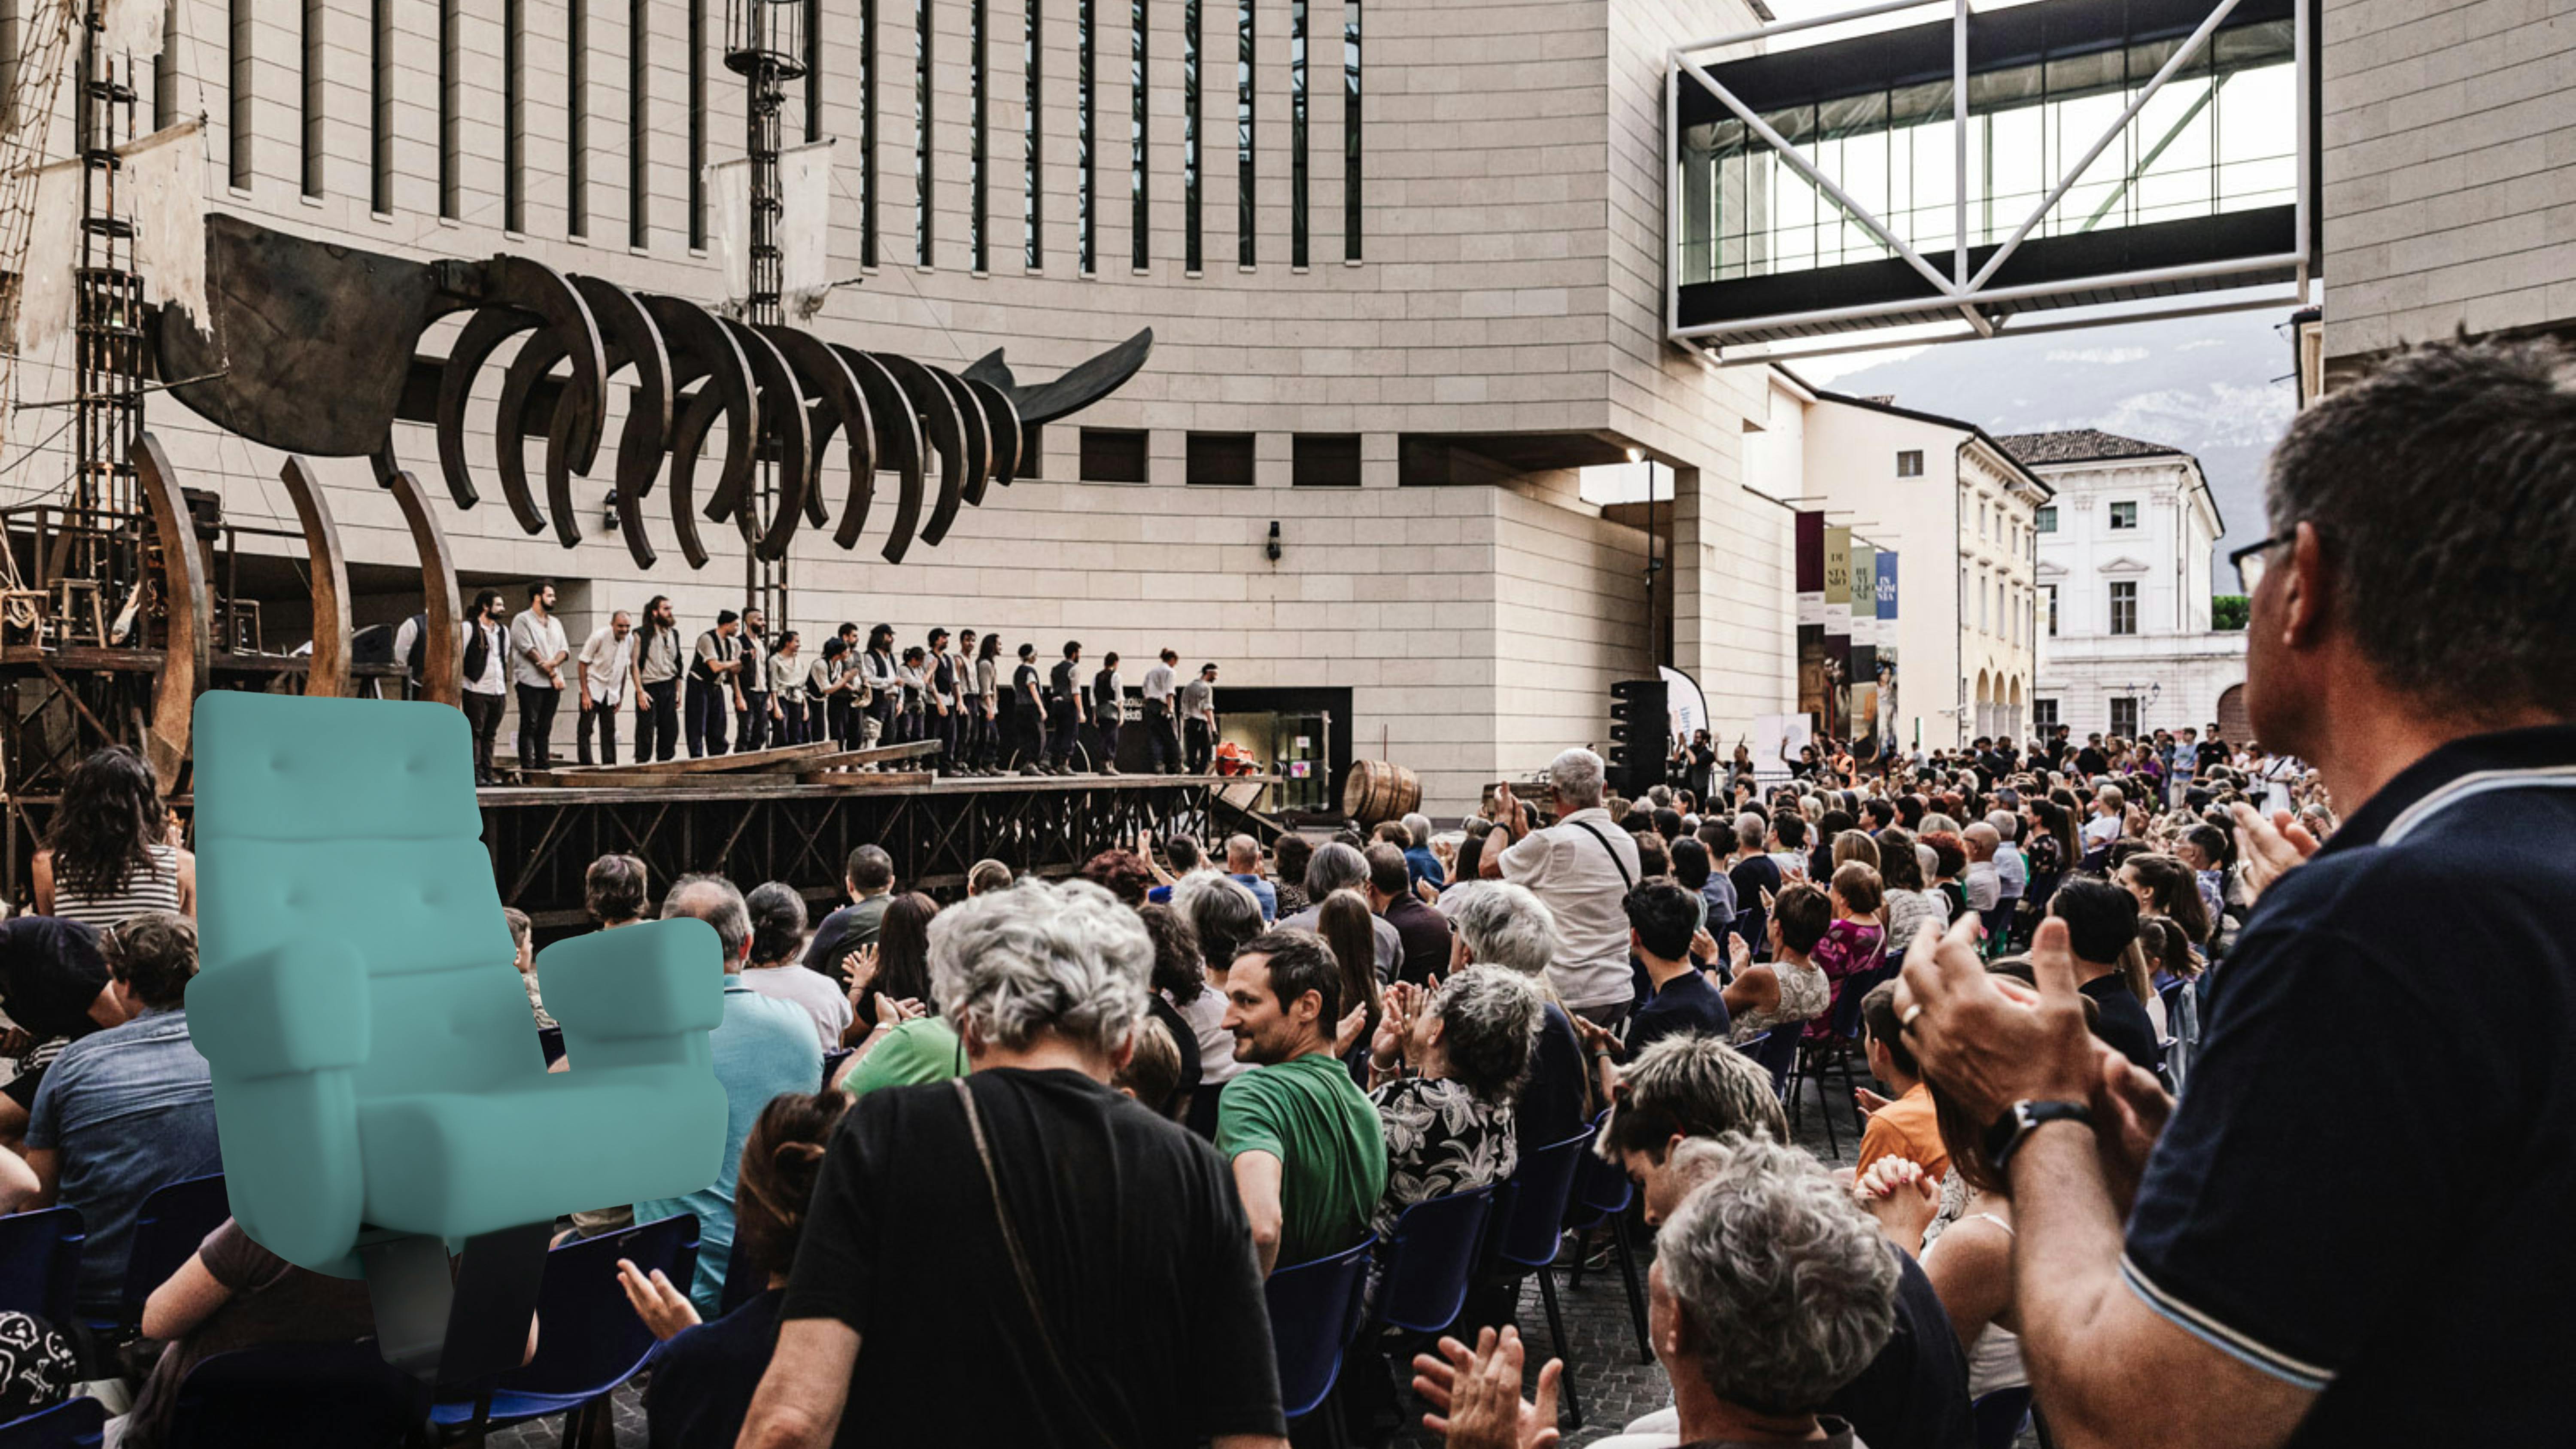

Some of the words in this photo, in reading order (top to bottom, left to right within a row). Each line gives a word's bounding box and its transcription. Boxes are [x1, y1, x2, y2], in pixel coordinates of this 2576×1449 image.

[1831, 553, 1843, 562] DI
[1827, 569, 1847, 577] STA
[1880, 576, 1889, 584] IN
[1877, 592, 1894, 601] NIA
